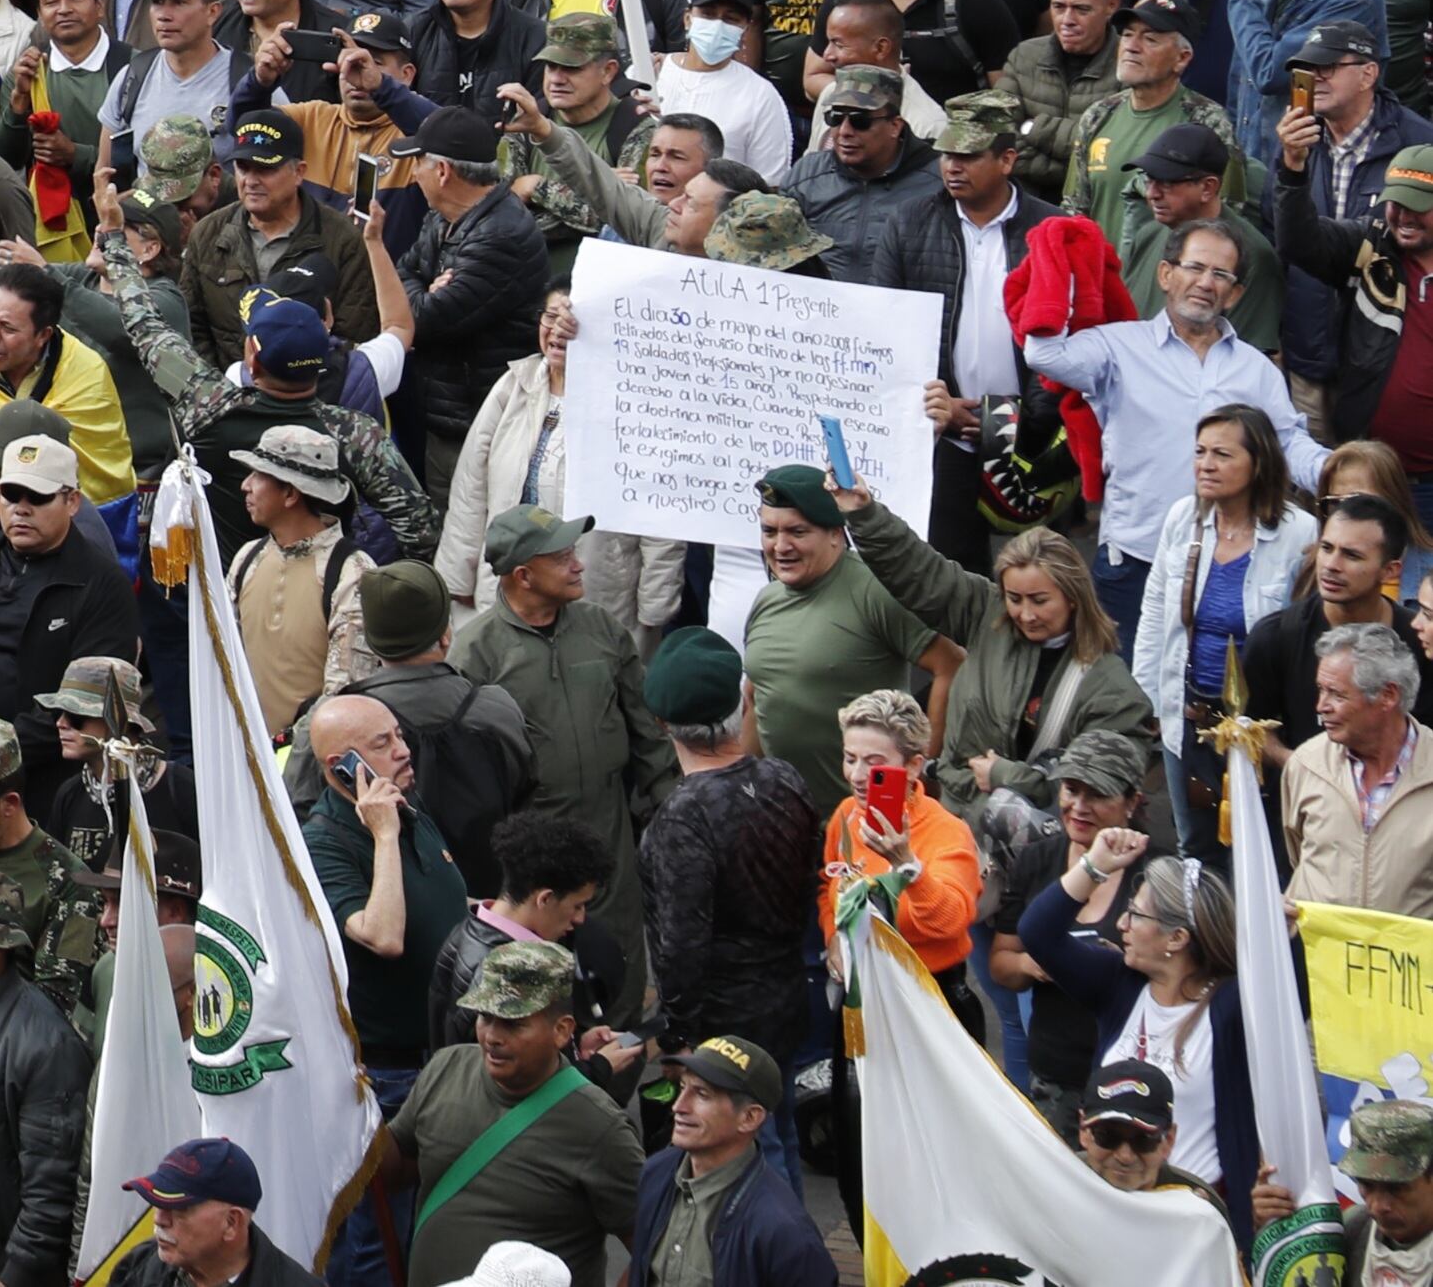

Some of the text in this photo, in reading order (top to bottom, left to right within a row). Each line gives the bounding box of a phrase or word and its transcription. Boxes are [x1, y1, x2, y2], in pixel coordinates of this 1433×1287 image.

[236, 122, 282, 140] VETERANO
[772, 286, 840, 320] Presente
[823, 333, 851, 354] 2008
[795, 421, 852, 453] Respo
[722, 496, 762, 524] Cas
[221, 921, 257, 956] RESPETO
[197, 1064, 257, 1091] OSIPAR
